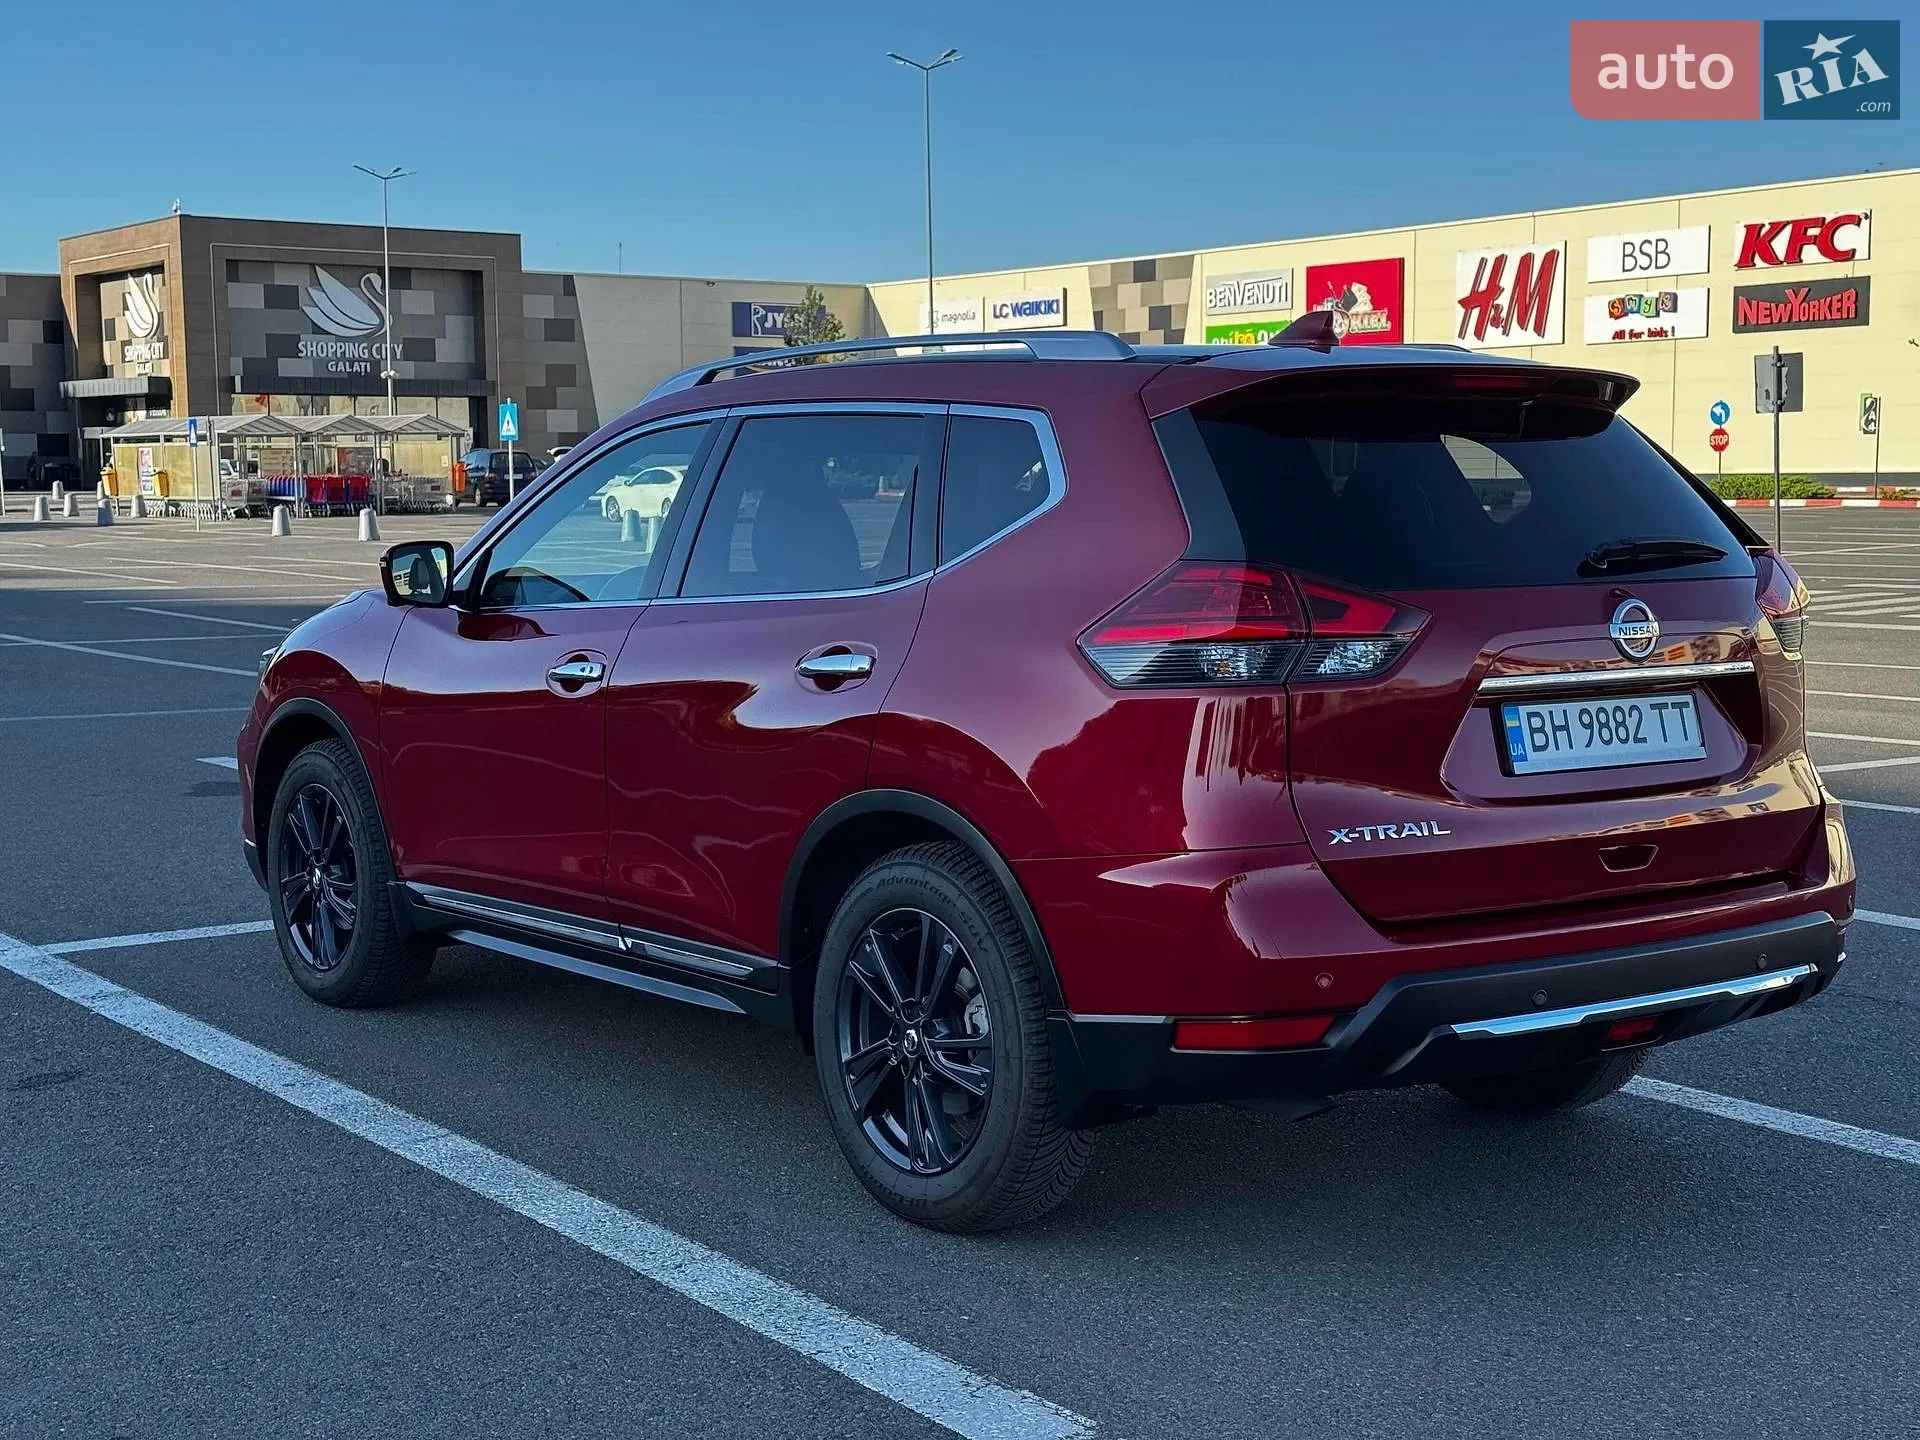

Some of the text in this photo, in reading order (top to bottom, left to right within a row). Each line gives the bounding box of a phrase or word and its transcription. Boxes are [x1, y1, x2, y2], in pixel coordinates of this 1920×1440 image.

[1735, 214, 1862, 268] KFC
[1622, 238, 1672, 273] BSB
[1457, 248, 1560, 342] H&M
[941, 309, 976, 324] magnolia
[992, 303, 1010, 319] LC
[297, 341, 369, 359] SHOPPING
[1710, 433, 1729, 445] STOP
[1618, 624, 1659, 637] NISSAN
[1509, 701, 1690, 756] UA BH 9882 TT
[1326, 820, 1452, 846] X-TRAIL
